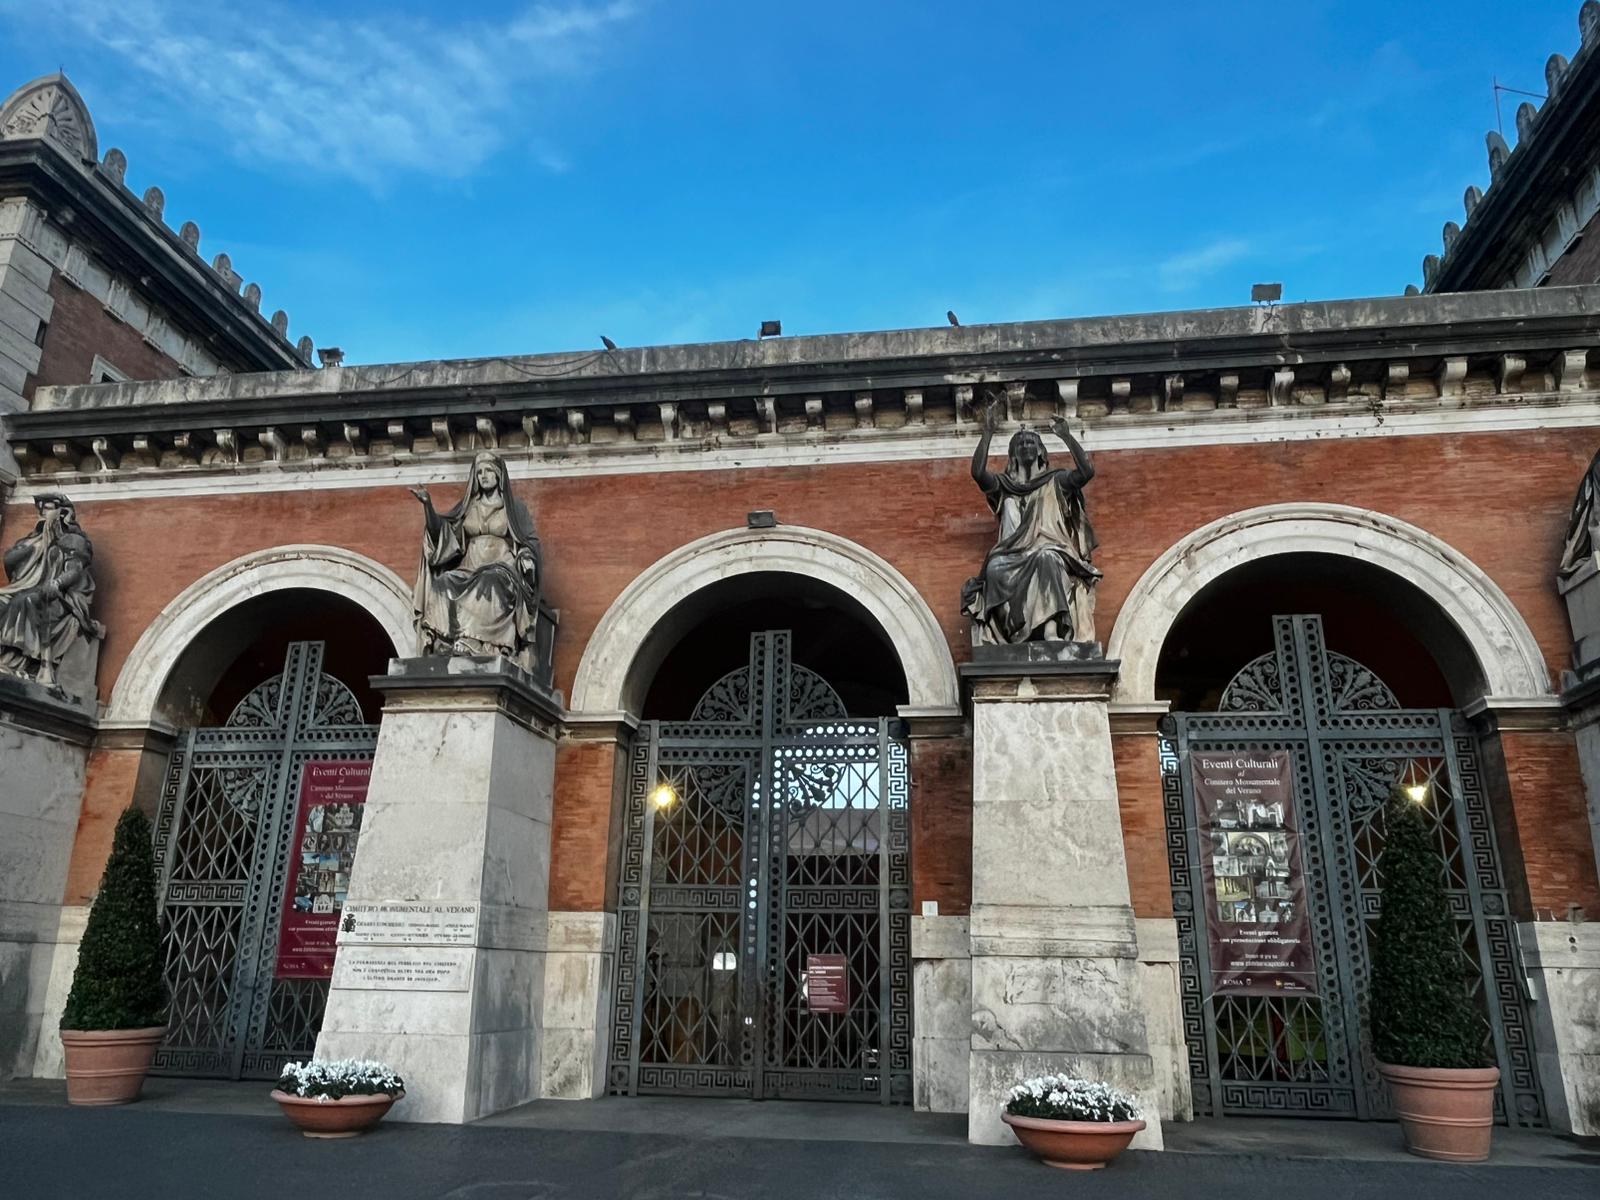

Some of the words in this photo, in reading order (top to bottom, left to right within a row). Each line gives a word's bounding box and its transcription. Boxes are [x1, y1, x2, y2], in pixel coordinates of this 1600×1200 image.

[1202, 758, 1233, 768] Eventi
[1236, 758, 1278, 768] Culturali
[312, 767, 338, 776] Eventi
[339, 766, 371, 776] Cultural
[1235, 778, 1280, 786] Monumentale
[380, 904, 431, 913] MONUMENTALE
[446, 905, 476, 913] VERANO
